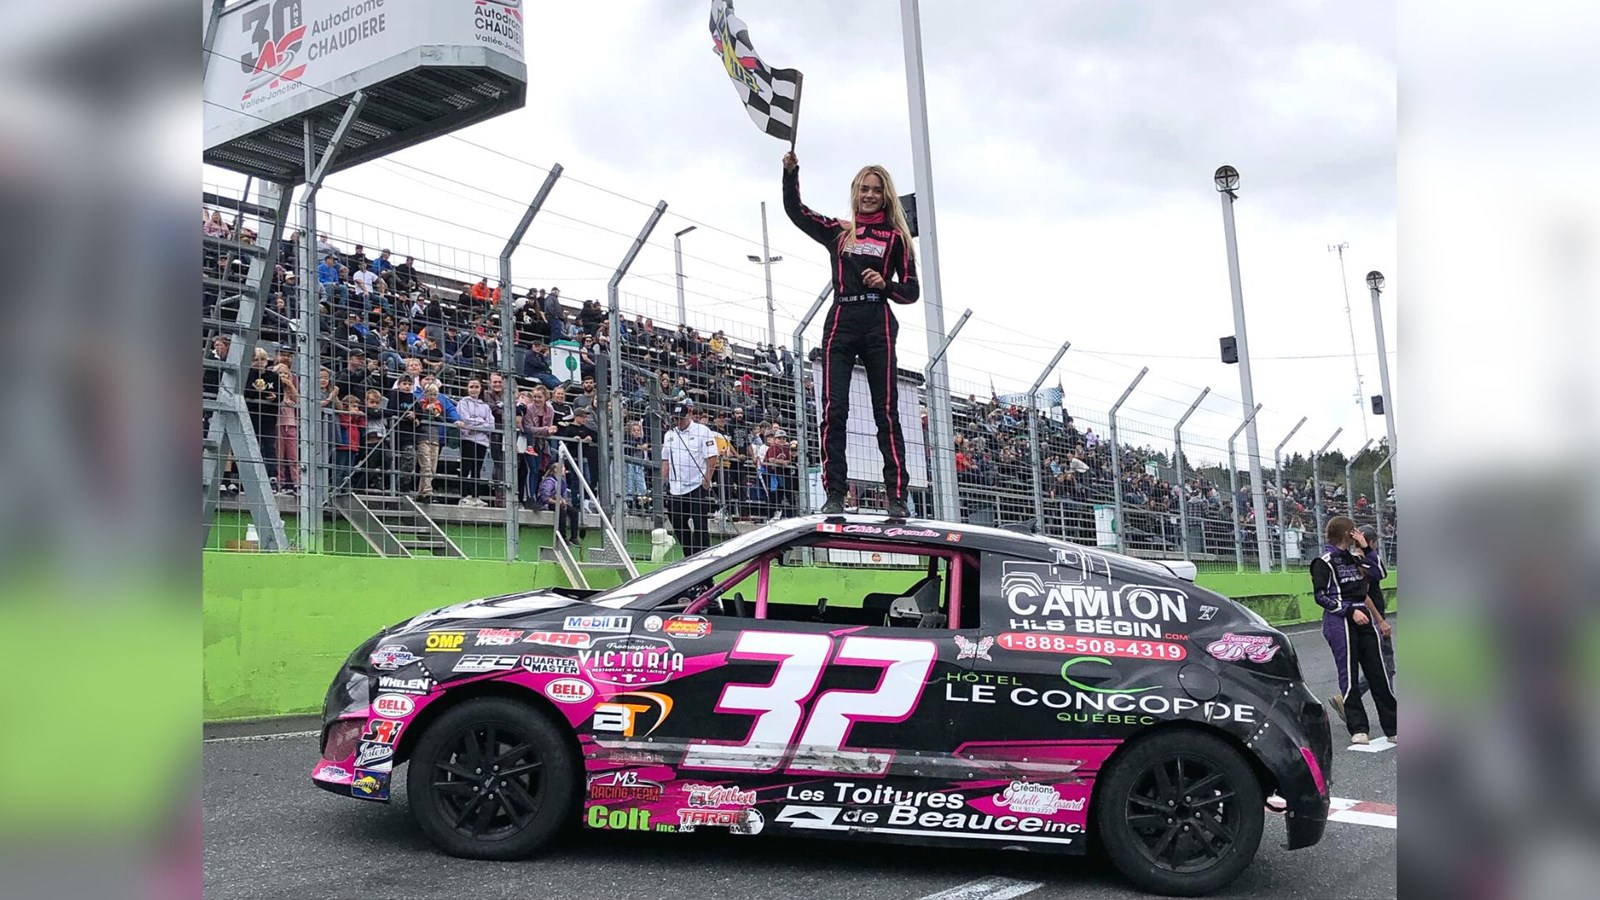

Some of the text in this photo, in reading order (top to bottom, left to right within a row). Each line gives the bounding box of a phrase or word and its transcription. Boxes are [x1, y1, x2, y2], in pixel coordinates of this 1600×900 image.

[311, 0, 384, 36] Autodrome
[308, 13, 386, 61] CHAUDIERE
[1007, 587, 1188, 623] CAMION
[568, 617, 628, 628] Mobil 1
[1010, 618, 1066, 632] HLS
[1075, 616, 1162, 639] BÉGIN
[426, 635, 464, 648] OMP
[475, 637, 515, 646] MSD
[528, 633, 589, 646] ARP
[607, 642, 657, 651] Fromagerie
[1003, 634, 1182, 659] 1-888-508-4319
[459, 656, 519, 666] PFC
[523, 656, 576, 667] QUARTER
[578, 650, 683, 672] VICTORIA
[532, 665, 578, 674] MASTER
[379, 676, 428, 690] WHELEN
[946, 672, 1023, 686] HÔTEL
[552, 683, 586, 695] BELL
[946, 683, 996, 704] LE
[378, 699, 407, 711] BELL
[678, 630, 939, 778] 32
[1057, 712, 1154, 725] QUÉBEC
[613, 772, 638, 787] M3
[592, 786, 628, 799] RACING
[1012, 782, 1054, 794] Créations
[786, 782, 965, 809] Les Toitures
[588, 805, 651, 831] Colt
[842, 805, 1086, 834] de Beauce inc.
